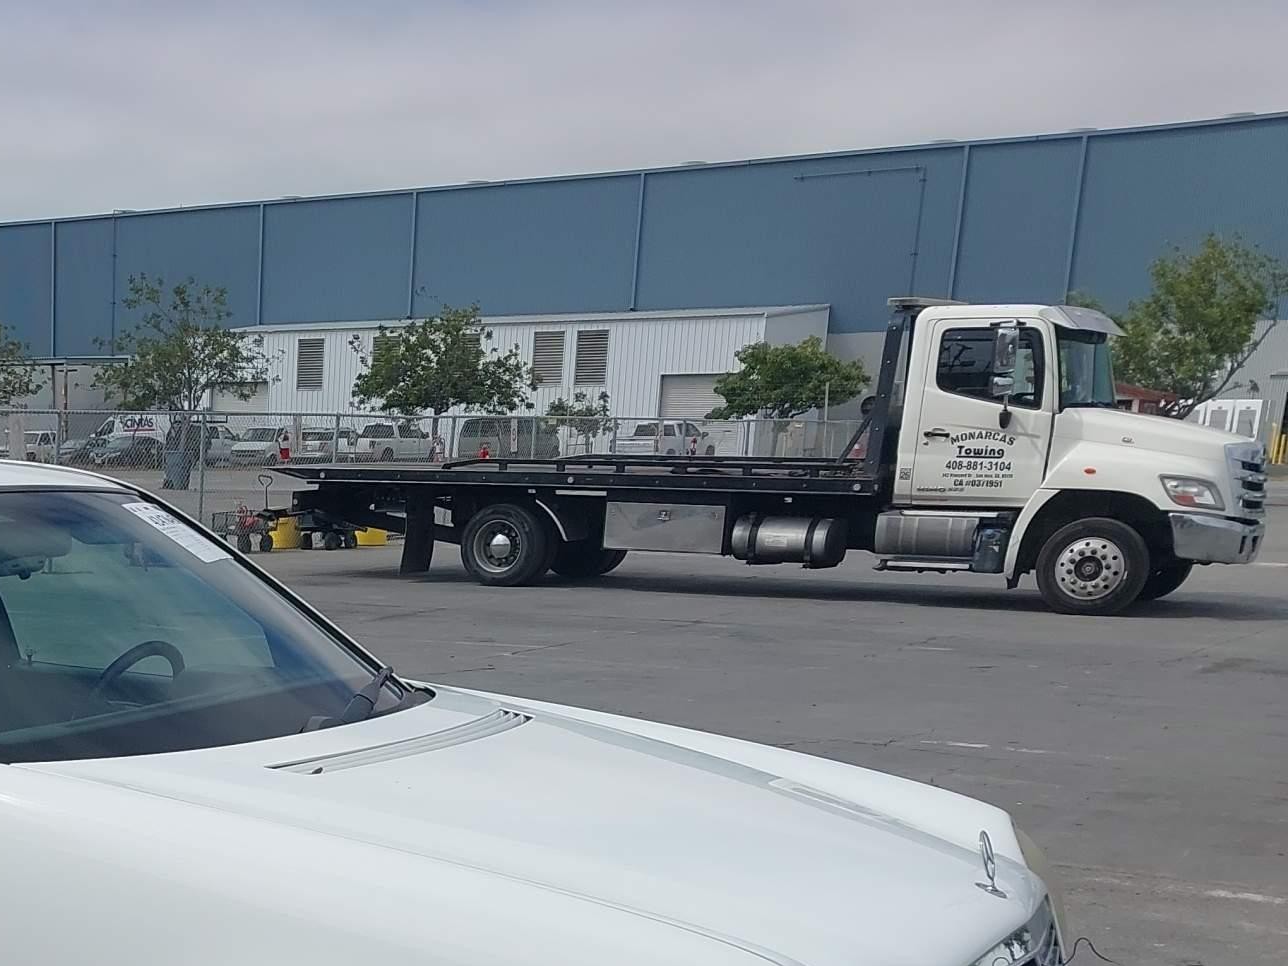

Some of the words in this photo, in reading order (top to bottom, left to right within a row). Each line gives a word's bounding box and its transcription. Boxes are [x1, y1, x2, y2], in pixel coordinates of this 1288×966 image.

[950, 431, 1016, 446] MONARCAS
[956, 446, 1005, 459] Towing
[945, 460, 1012, 471] 408-881-3104
[953, 479, 964, 487] CA
